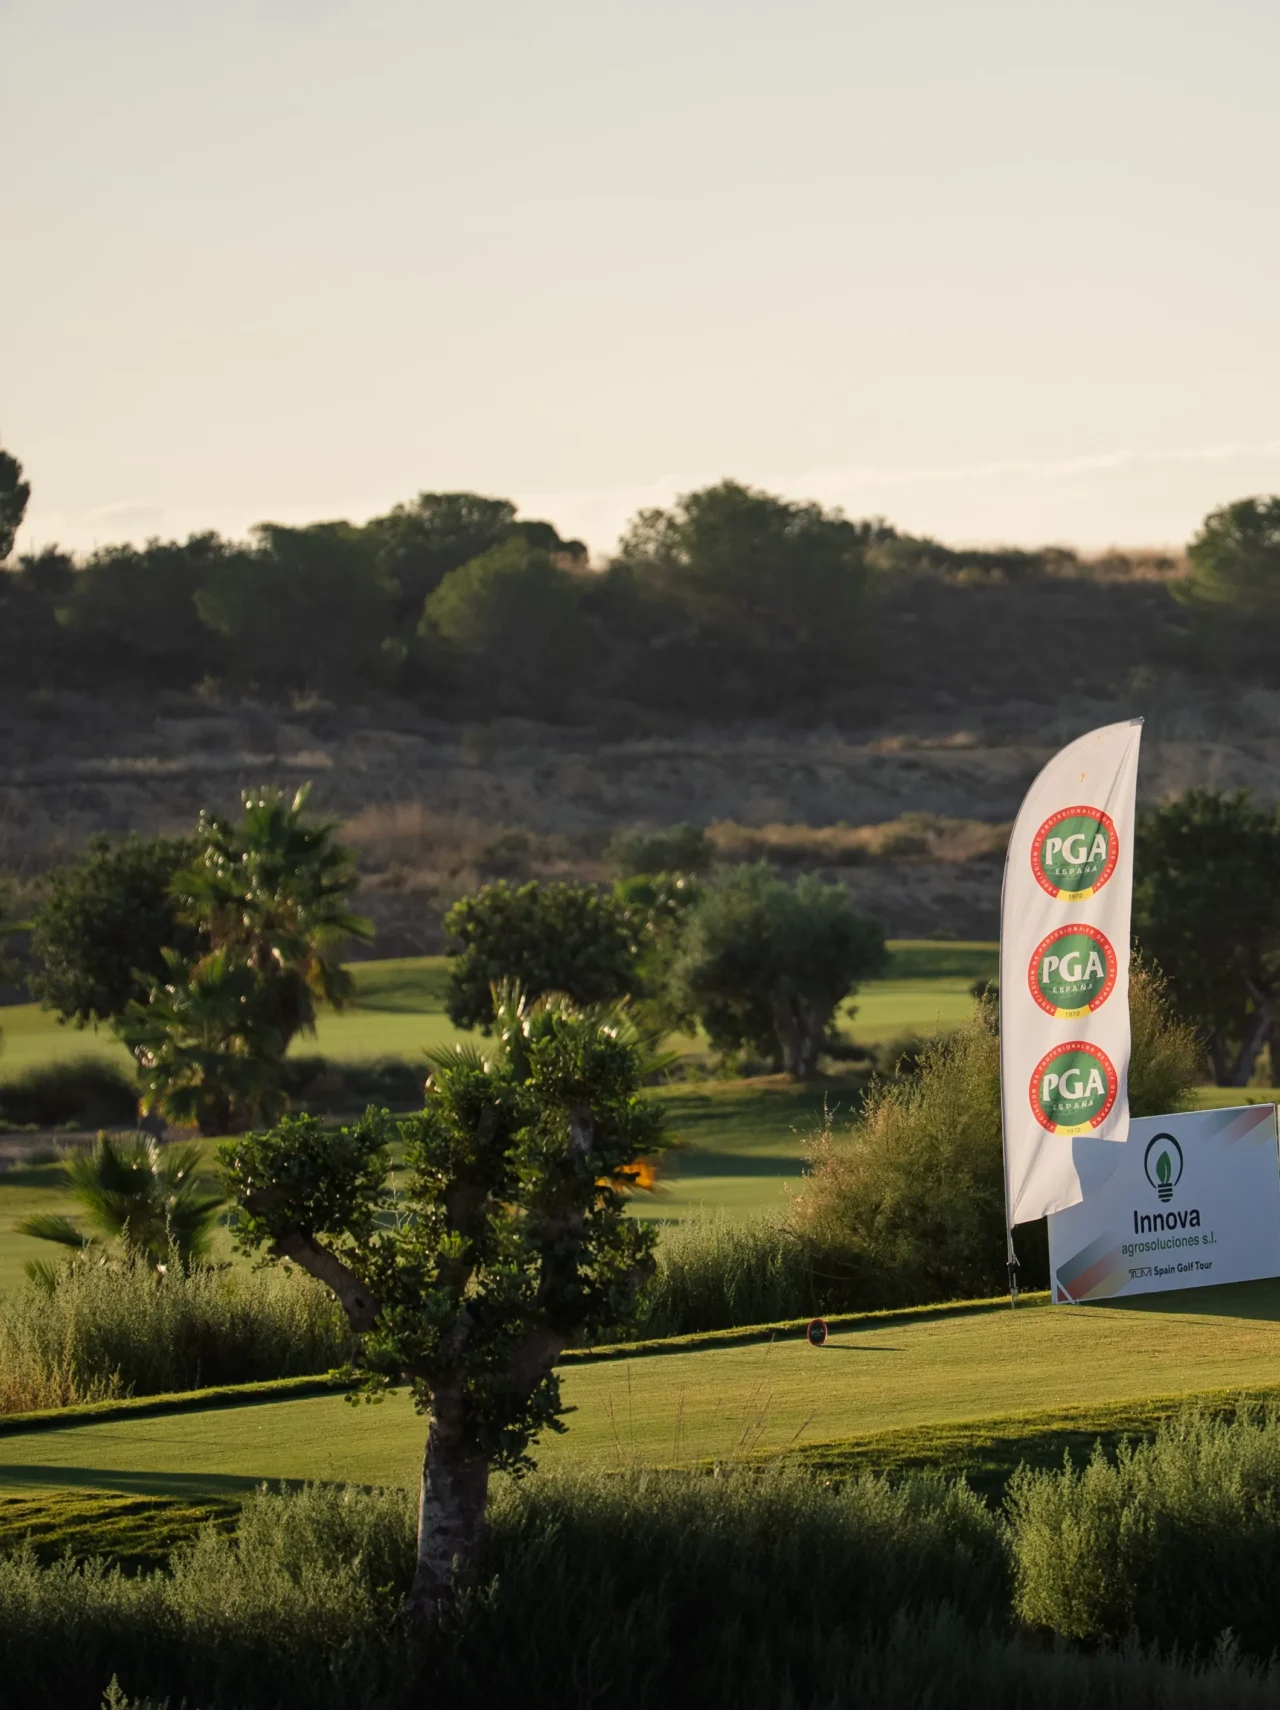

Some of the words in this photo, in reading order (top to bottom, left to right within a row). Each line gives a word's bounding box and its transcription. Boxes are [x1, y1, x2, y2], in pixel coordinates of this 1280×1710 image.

[1045, 833, 1107, 865] PGA
[1055, 865, 1098, 875] ESPAÑA
[1042, 951, 1104, 984] PGA
[1052, 983, 1093, 993] ESPAÑA
[1043, 1068, 1105, 1102] PGA
[1052, 1100, 1094, 1111] ESPAÑA
[1133, 1208, 1201, 1234] Innova
[1121, 1235, 1200, 1257] agrosoluciones
[1202, 1231, 1217, 1245] s.l.
[1153, 1264, 1175, 1278] Spain
[1176, 1261, 1194, 1273] Golf
[1194, 1261, 1213, 1270] Tour
